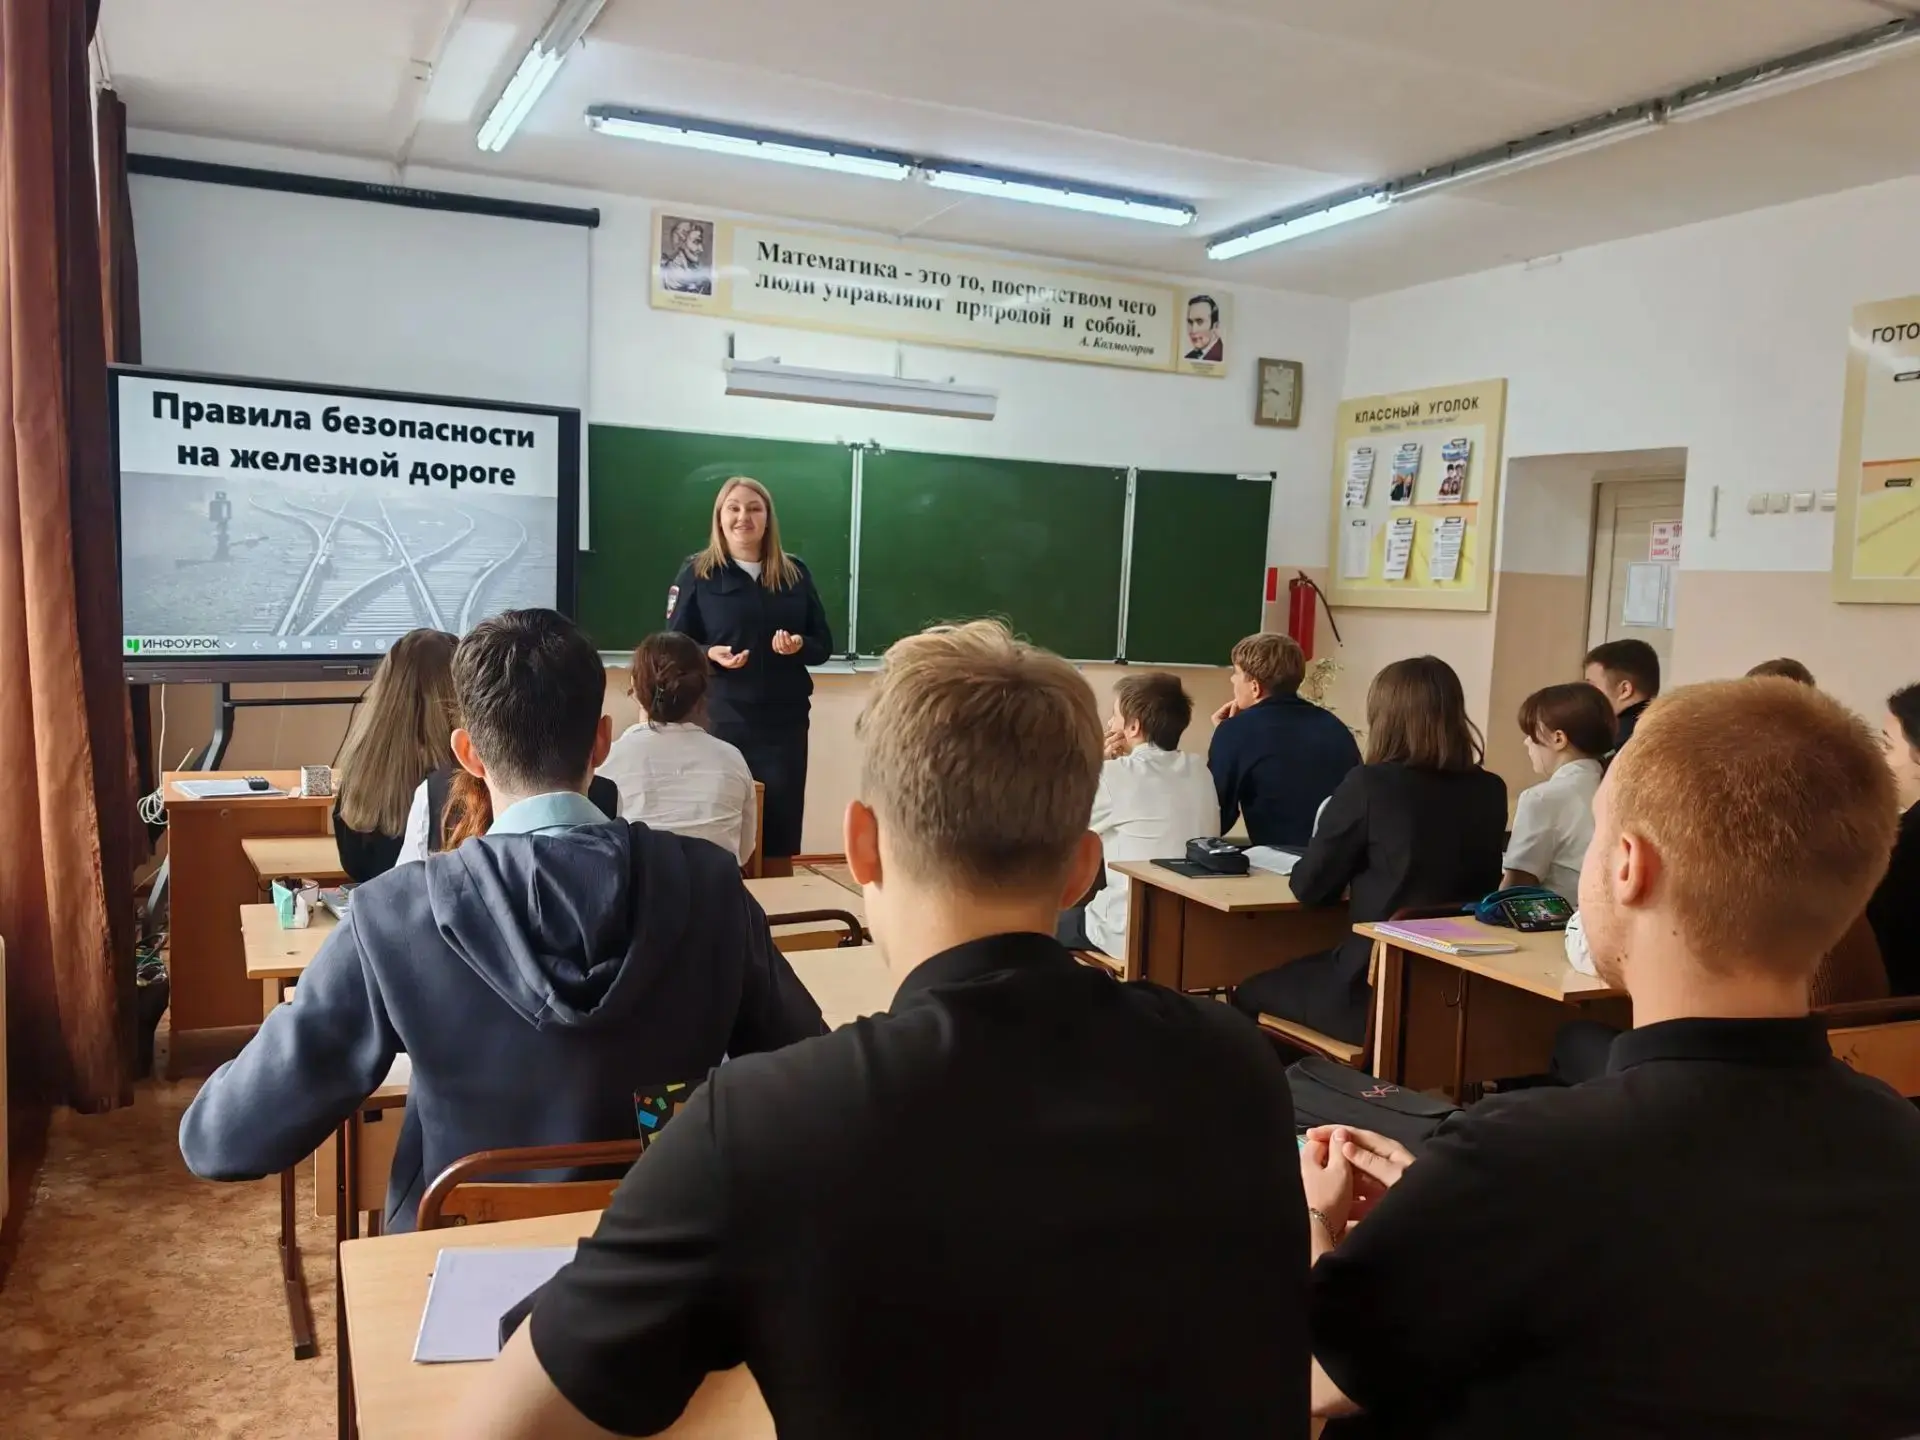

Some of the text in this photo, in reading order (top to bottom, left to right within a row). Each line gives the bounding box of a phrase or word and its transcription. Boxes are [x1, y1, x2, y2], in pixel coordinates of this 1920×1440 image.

[755, 272, 1142, 338] люди управляют природой и собой.
[757, 240, 898, 279] Математика
[918, 267, 952, 287] это
[957, 273, 986, 294] то,
[992, 279, 1112, 309] посредством
[1118, 299, 1157, 318] чего
[152, 390, 536, 449] Правила безопасности
[1355, 402, 1420, 423] КЛАССНЫЙ
[1429, 397, 1479, 415] УГОЛОК
[177, 444, 517, 490] на железной дороге
[142, 638, 220, 650] ИНФОУРОК
